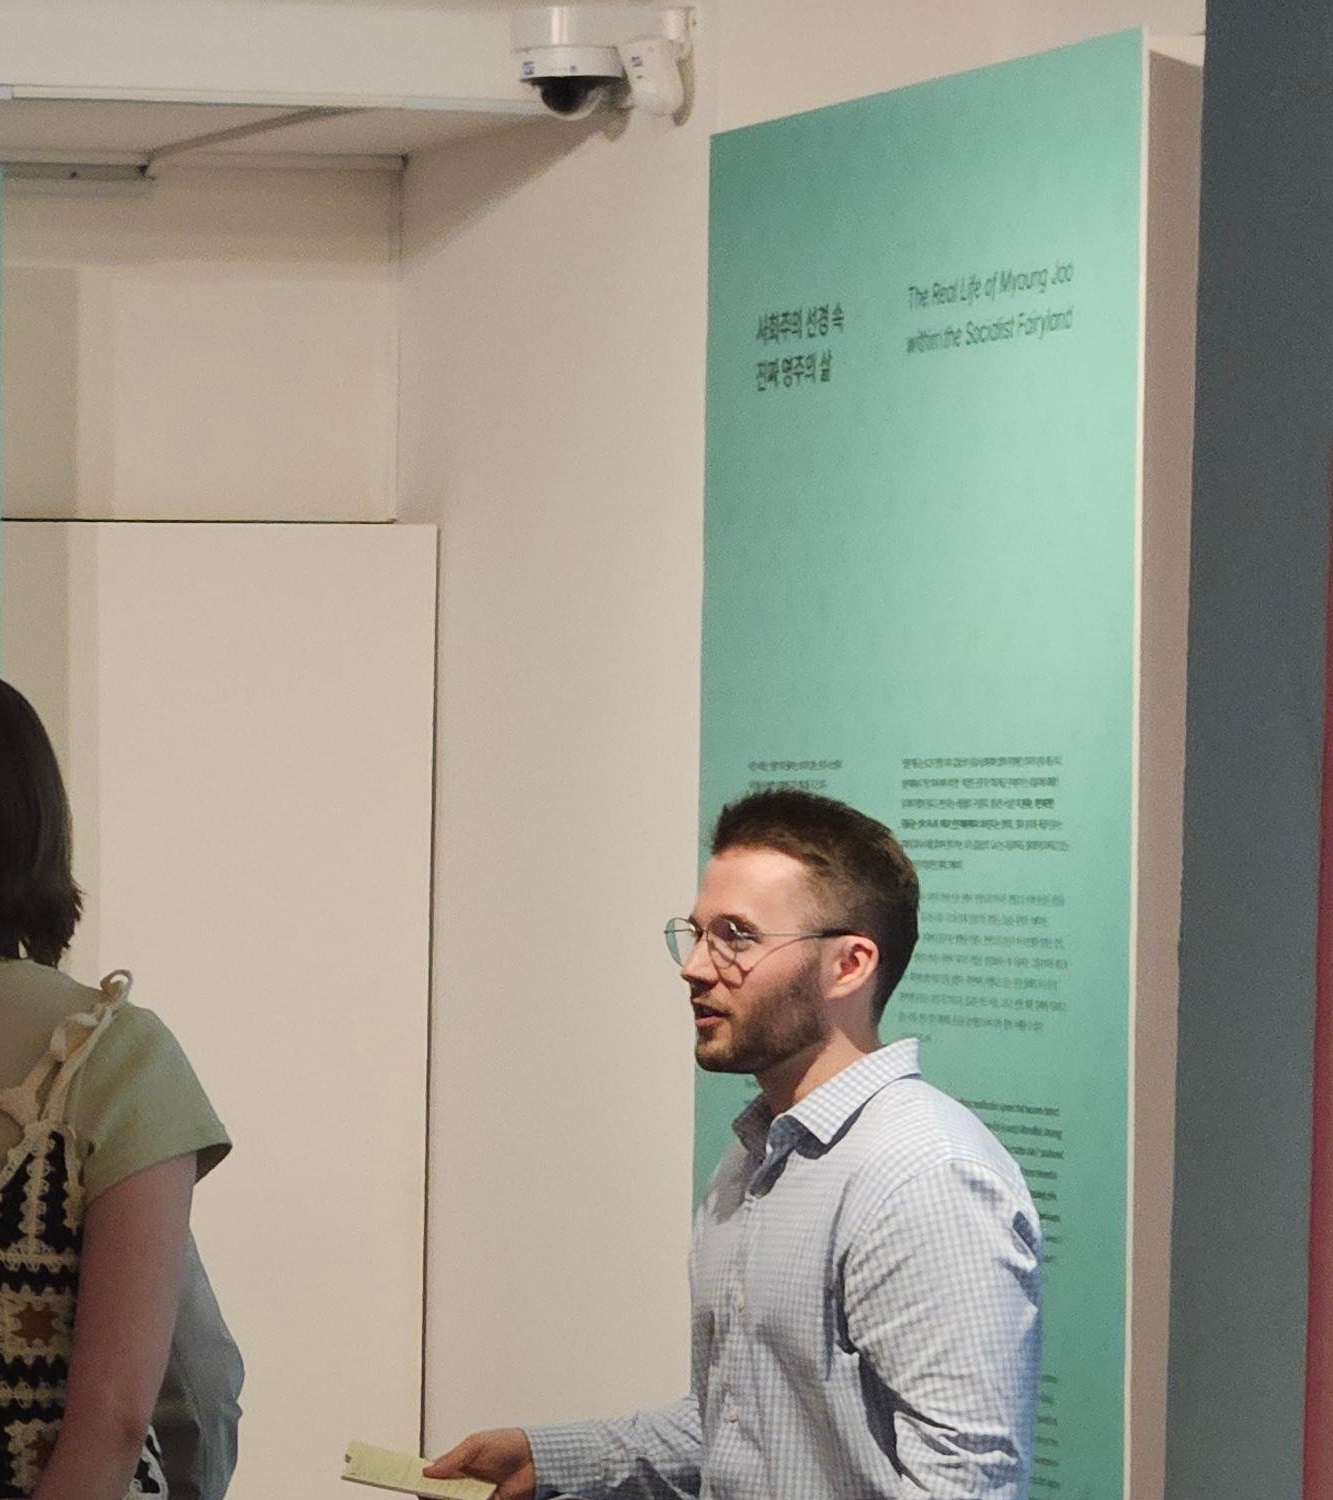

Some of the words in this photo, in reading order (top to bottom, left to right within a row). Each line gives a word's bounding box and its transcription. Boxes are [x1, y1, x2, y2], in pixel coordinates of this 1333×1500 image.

[908, 286, 929, 310] The
[985, 270, 999, 301] of
[965, 316, 1015, 346] Socialist
